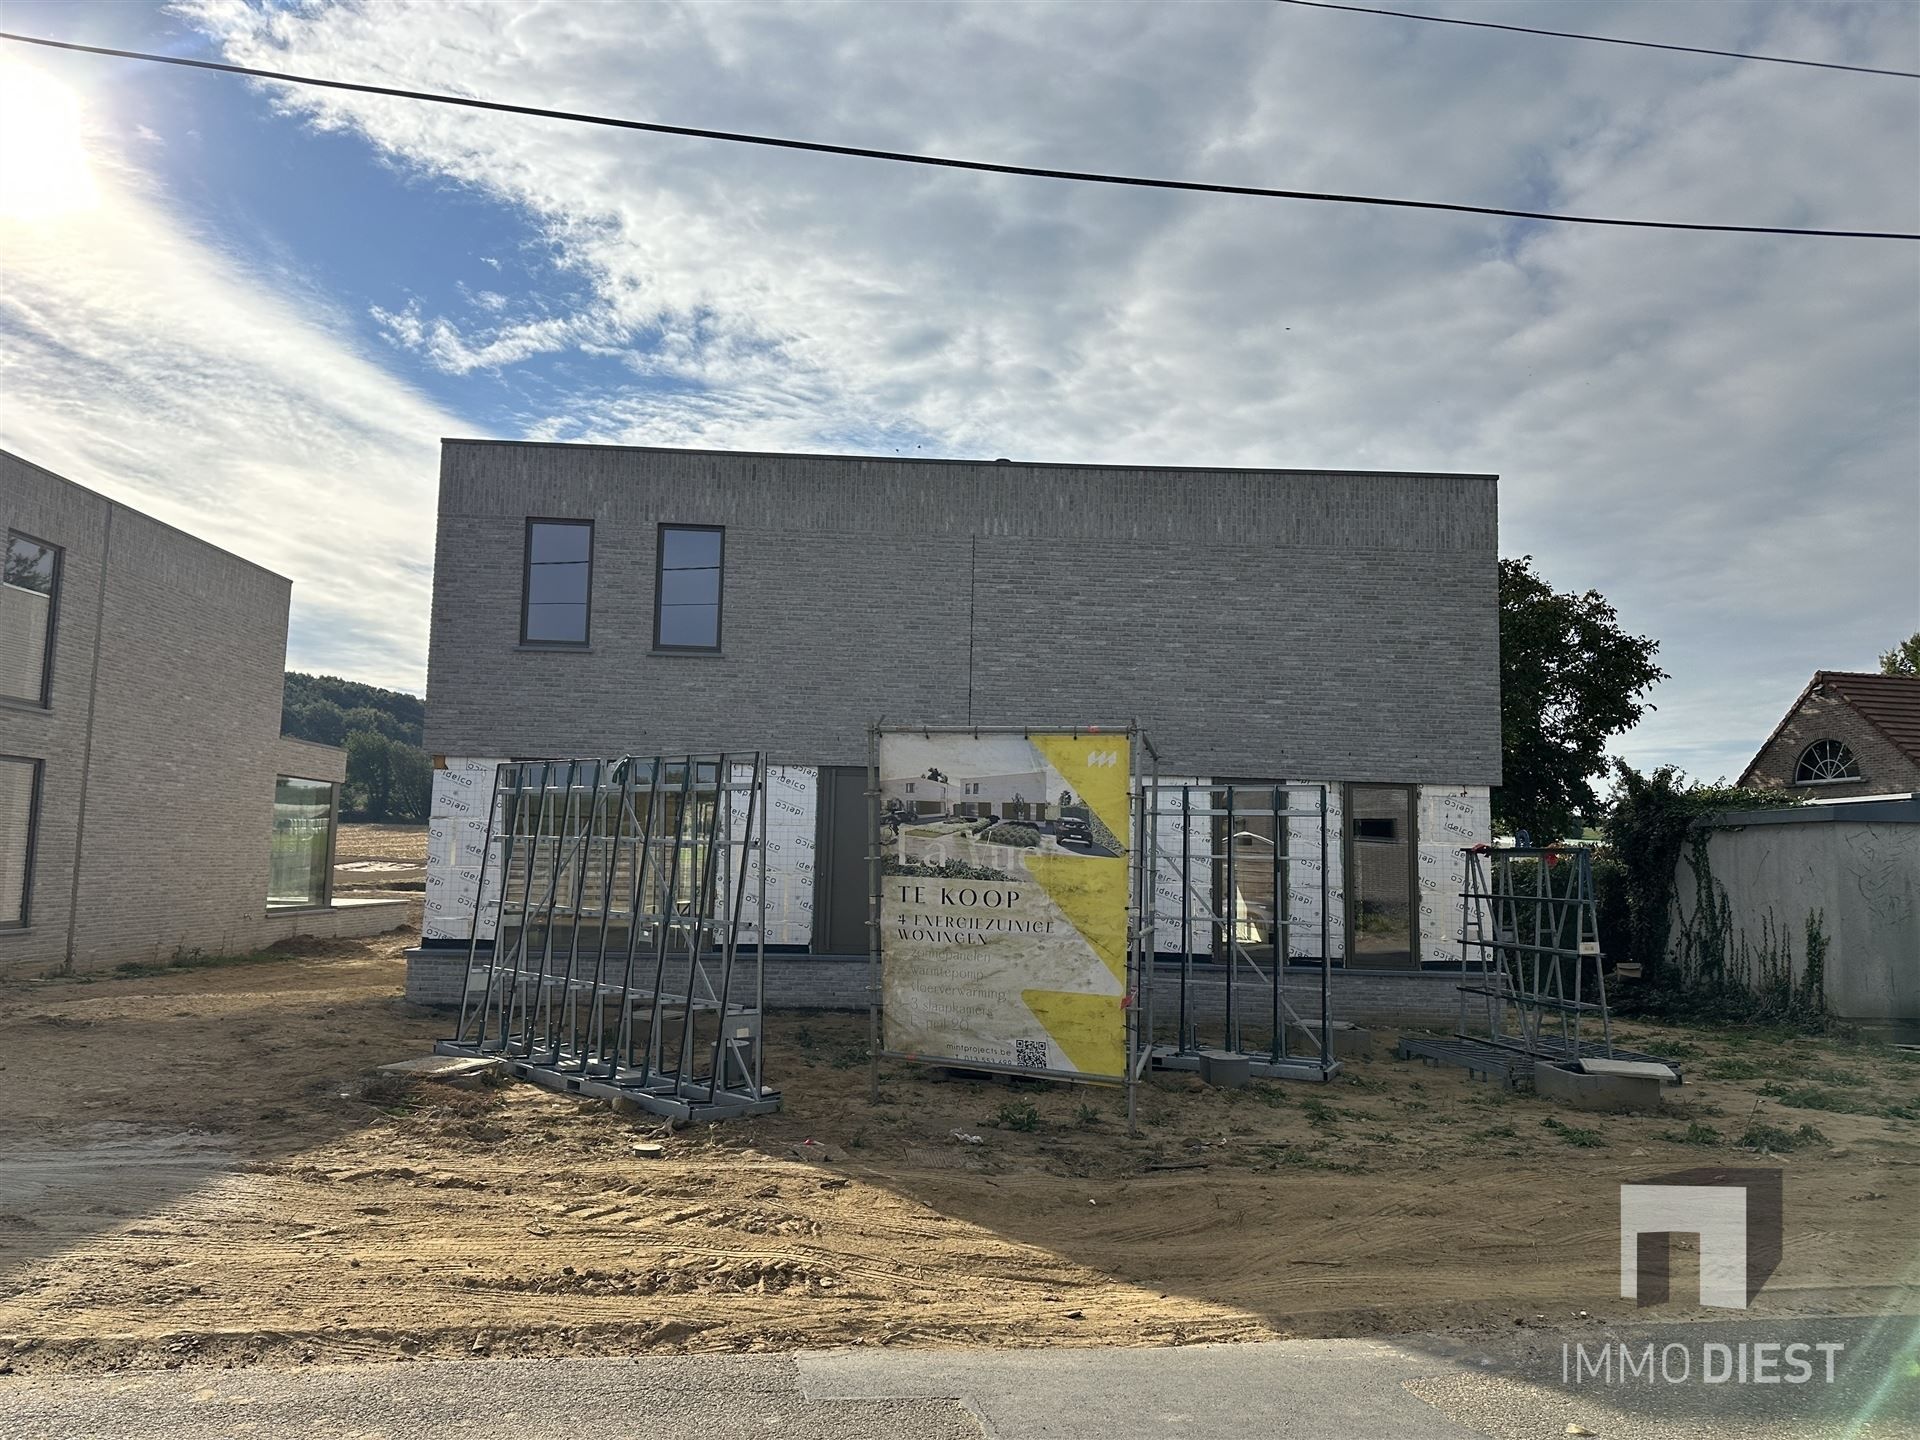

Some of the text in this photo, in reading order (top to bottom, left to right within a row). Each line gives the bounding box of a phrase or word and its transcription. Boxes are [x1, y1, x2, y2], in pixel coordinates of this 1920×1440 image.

[441, 771, 472, 786] idelco
[777, 776, 805, 790] idelco
[440, 797, 469, 812] idelco
[775, 801, 804, 816] idelco
[1444, 799, 1473, 814] idelco
[1444, 822, 1473, 837] idelco
[796, 861, 813, 871] idel
[1419, 854, 1436, 864] idel
[897, 886, 1020, 908] TE KOOP
[1289, 892, 1312, 904] idelc
[898, 914, 1055, 934] 4 ENERGIEZUINIGE
[898, 929, 987, 945] WONINGEN
[1164, 940, 1181, 950] idel
[946, 1042, 1012, 1056] mintprojects.be
